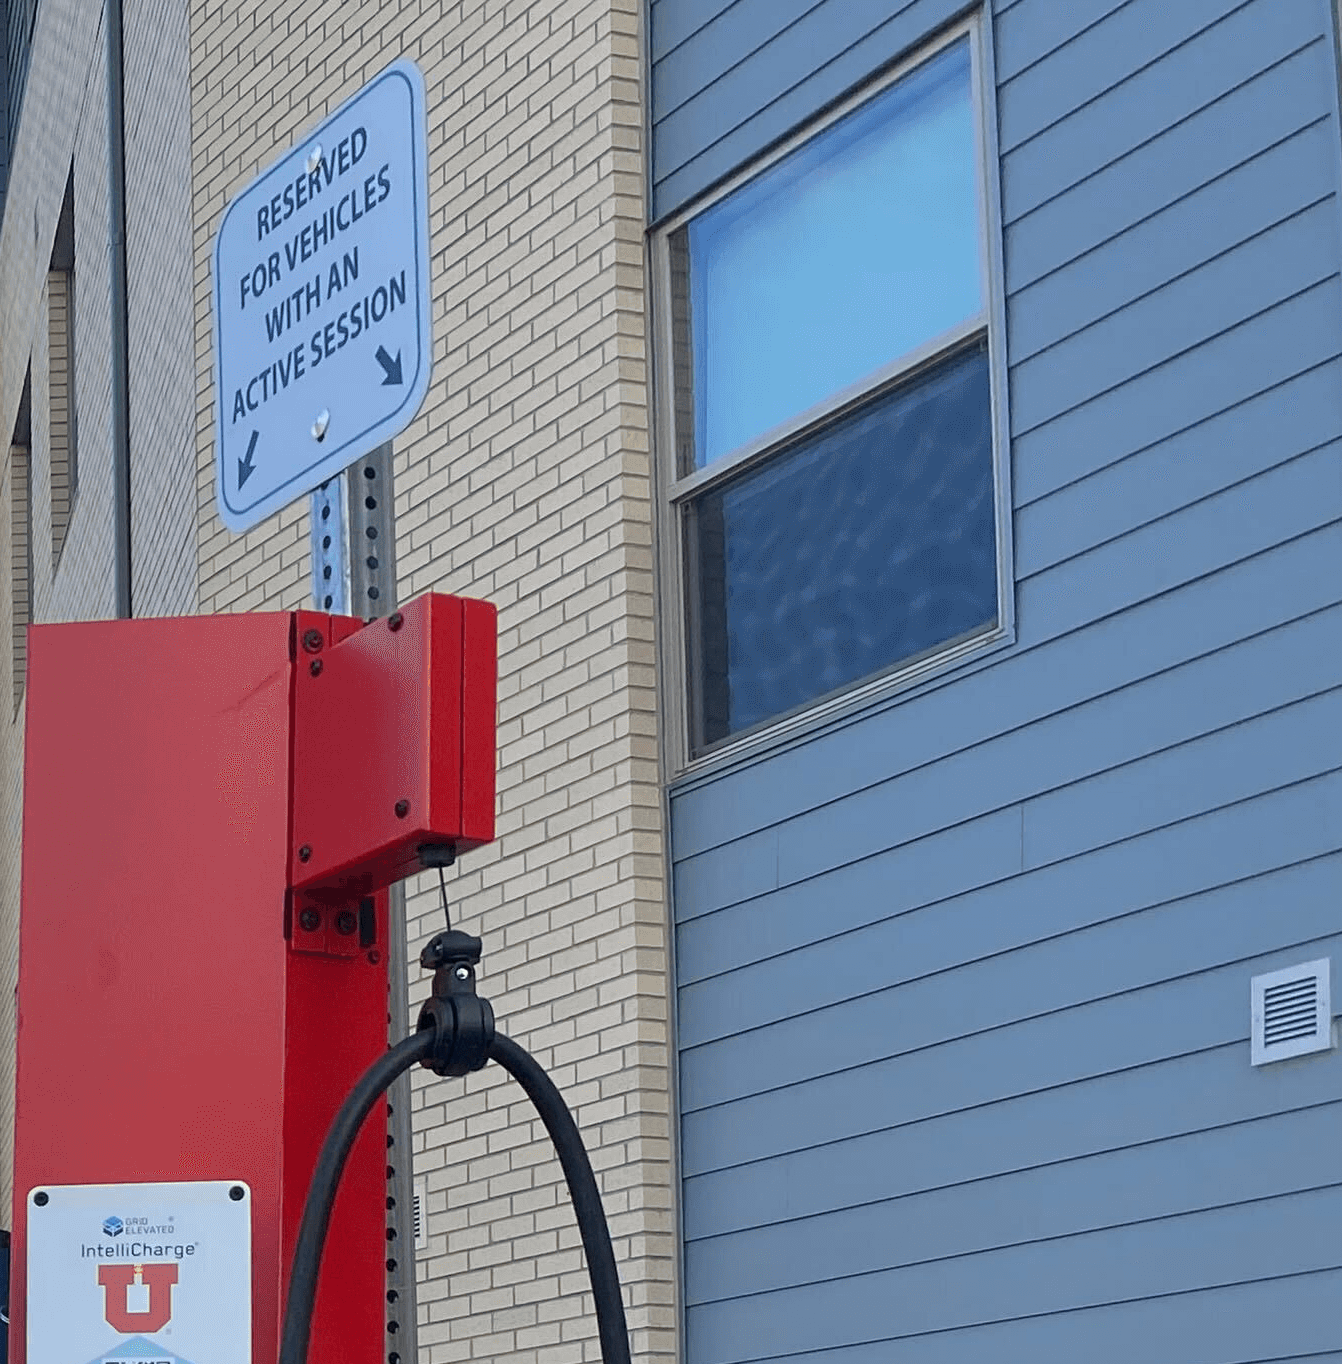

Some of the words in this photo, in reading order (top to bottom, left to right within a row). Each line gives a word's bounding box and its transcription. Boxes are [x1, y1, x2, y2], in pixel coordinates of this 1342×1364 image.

[257, 126, 367, 242] RESERVED
[240, 251, 281, 310] FOR
[284, 163, 391, 272] VEHICLES
[265, 274, 320, 343] WITH
[327, 246, 359, 300] AN
[232, 342, 306, 424] ACTIVE
[311, 270, 406, 367] SESSION
[81, 1242, 195, 1260] IntelliCharge
[125, 1217, 148, 1226] GRID
[125, 1225, 175, 1235] ELEVATED
[97, 1264, 178, 1333] U
